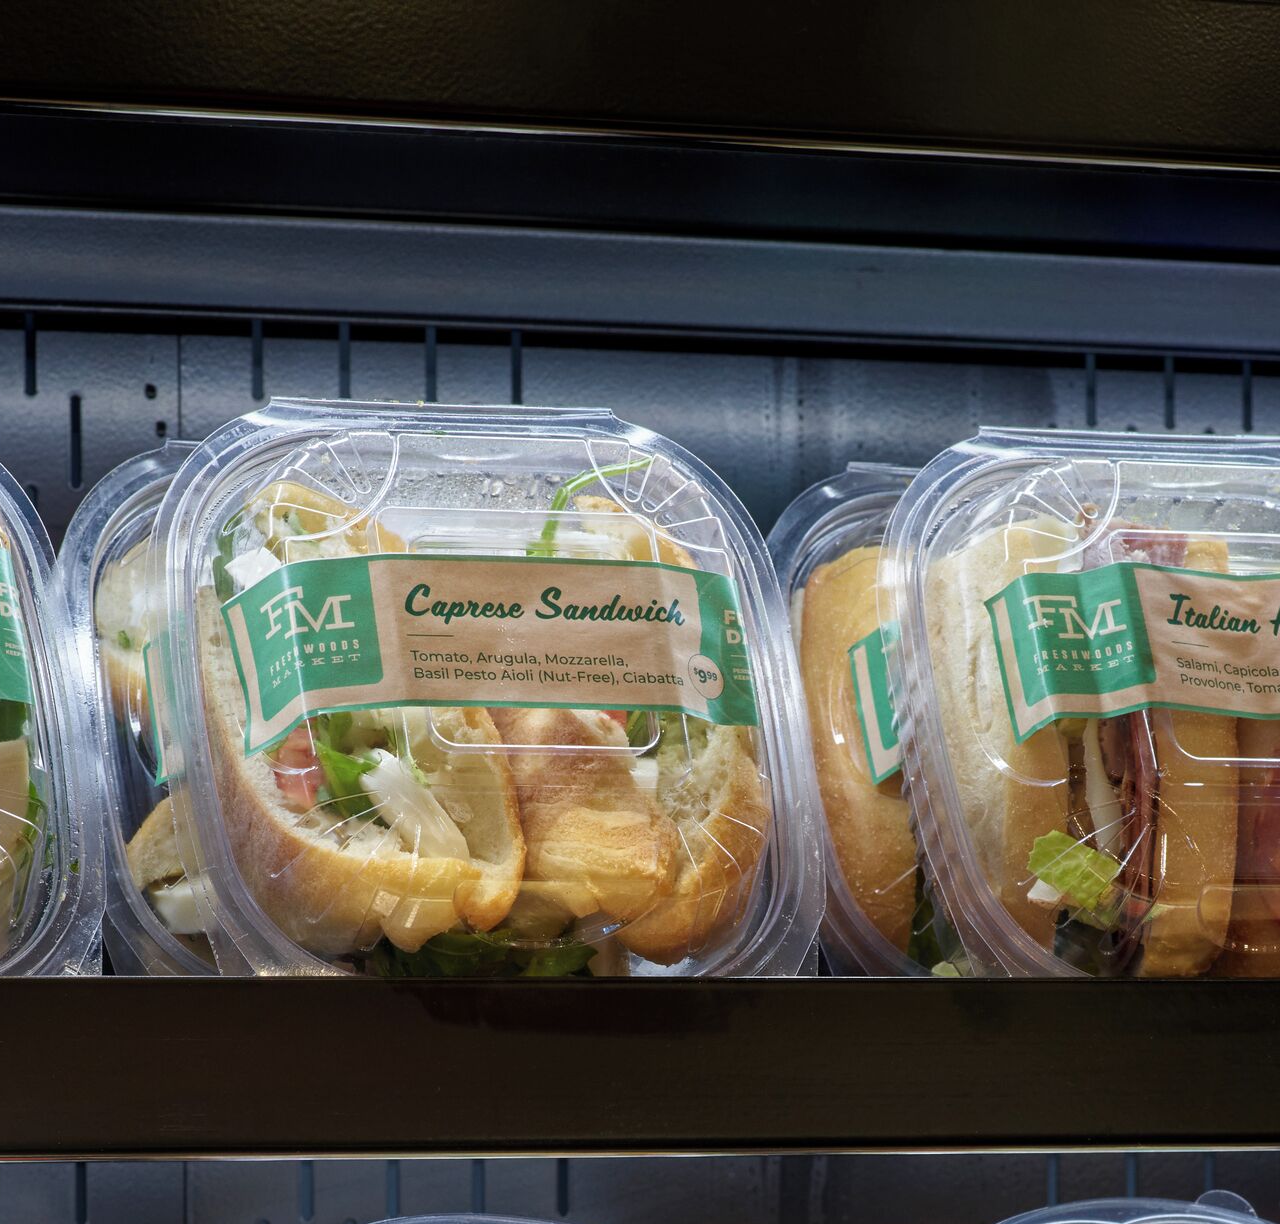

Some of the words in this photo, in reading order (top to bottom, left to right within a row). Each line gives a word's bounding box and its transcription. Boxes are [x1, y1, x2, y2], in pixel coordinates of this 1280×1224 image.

[260, 586, 355, 641] FM
[404, 583, 524, 625] Caprese
[535, 586, 686, 627] Sandwich
[1167, 593, 1261, 634] Italian
[270, 639, 360, 676] FRESHWOODS
[410, 650, 473, 665] Tomato,
[477, 652, 541, 667] Arugula,
[545, 653, 629, 668] Mozzarella,
[1176, 657, 1222, 673] Salami,
[414, 667, 449, 680] Basil
[454, 669, 496, 681] Pesto
[501, 669, 534, 682] Aioli
[538, 669, 620, 685] (Nut-Free),
[623, 672, 684, 686] Ciabatta
[1181, 673, 1245, 693] Provolone,
